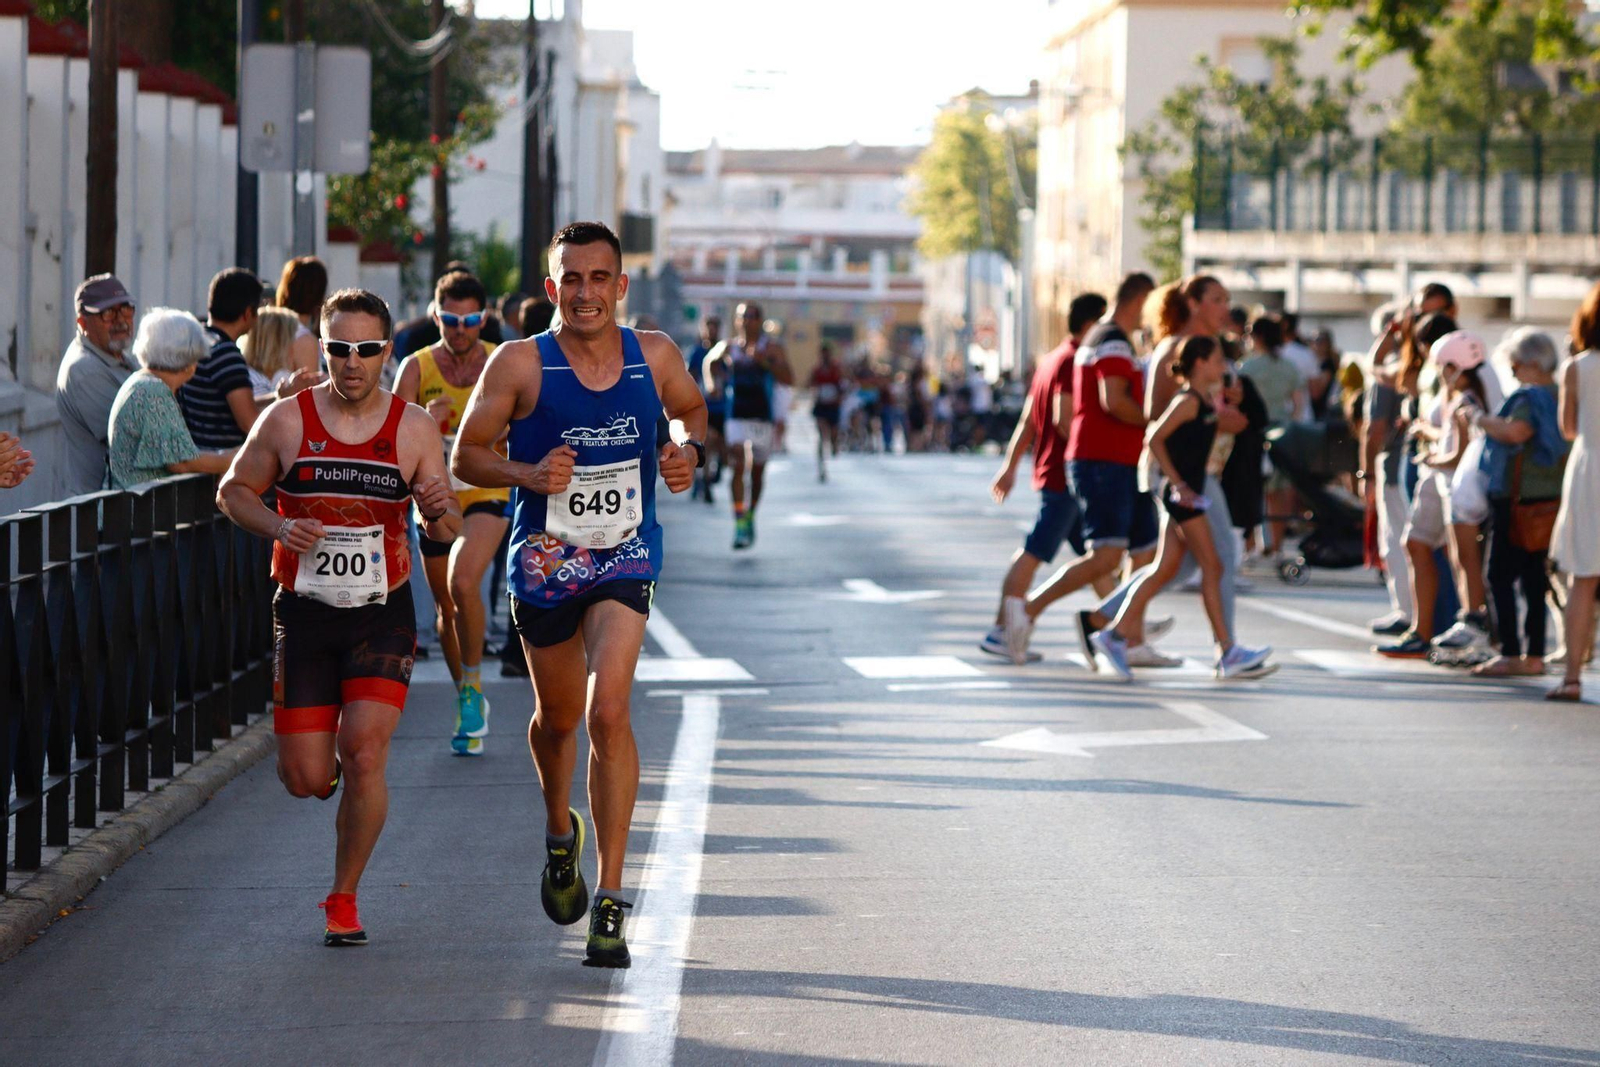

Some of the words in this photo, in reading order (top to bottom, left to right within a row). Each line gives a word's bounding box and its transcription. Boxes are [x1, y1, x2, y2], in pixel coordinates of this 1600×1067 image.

[565, 438, 579, 446] CLUB
[582, 438, 608, 447] TRIATLÓN
[315, 467, 398, 487] PubliPrenda
[569, 489, 621, 516] 649
[316, 551, 366, 576] 200
